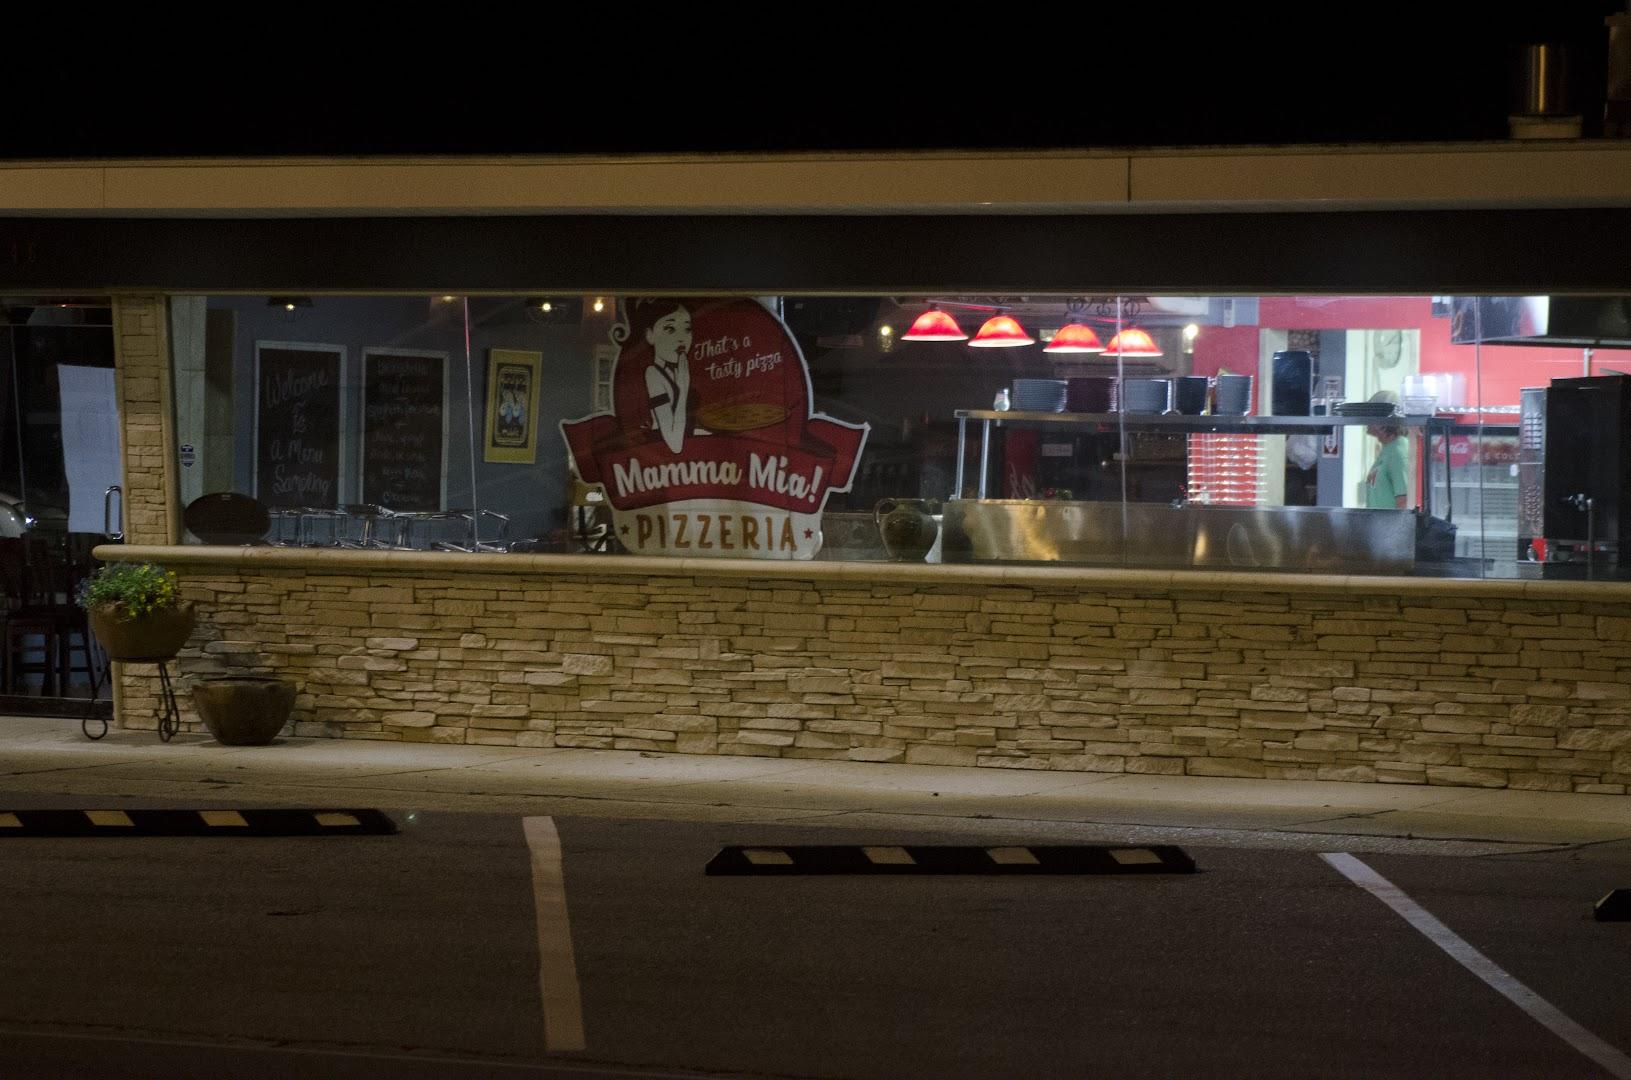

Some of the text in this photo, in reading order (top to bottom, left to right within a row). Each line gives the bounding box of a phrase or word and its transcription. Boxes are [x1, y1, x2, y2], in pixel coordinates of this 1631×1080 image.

[695, 337, 752, 361] That's a
[705, 352, 782, 381] tasty pizza
[266, 368, 329, 407] Welcome
[1439, 442, 1468, 454] Cca-Cola
[613, 453, 823, 503] Mamma Mia!
[637, 514, 797, 551] PIZZERIA
